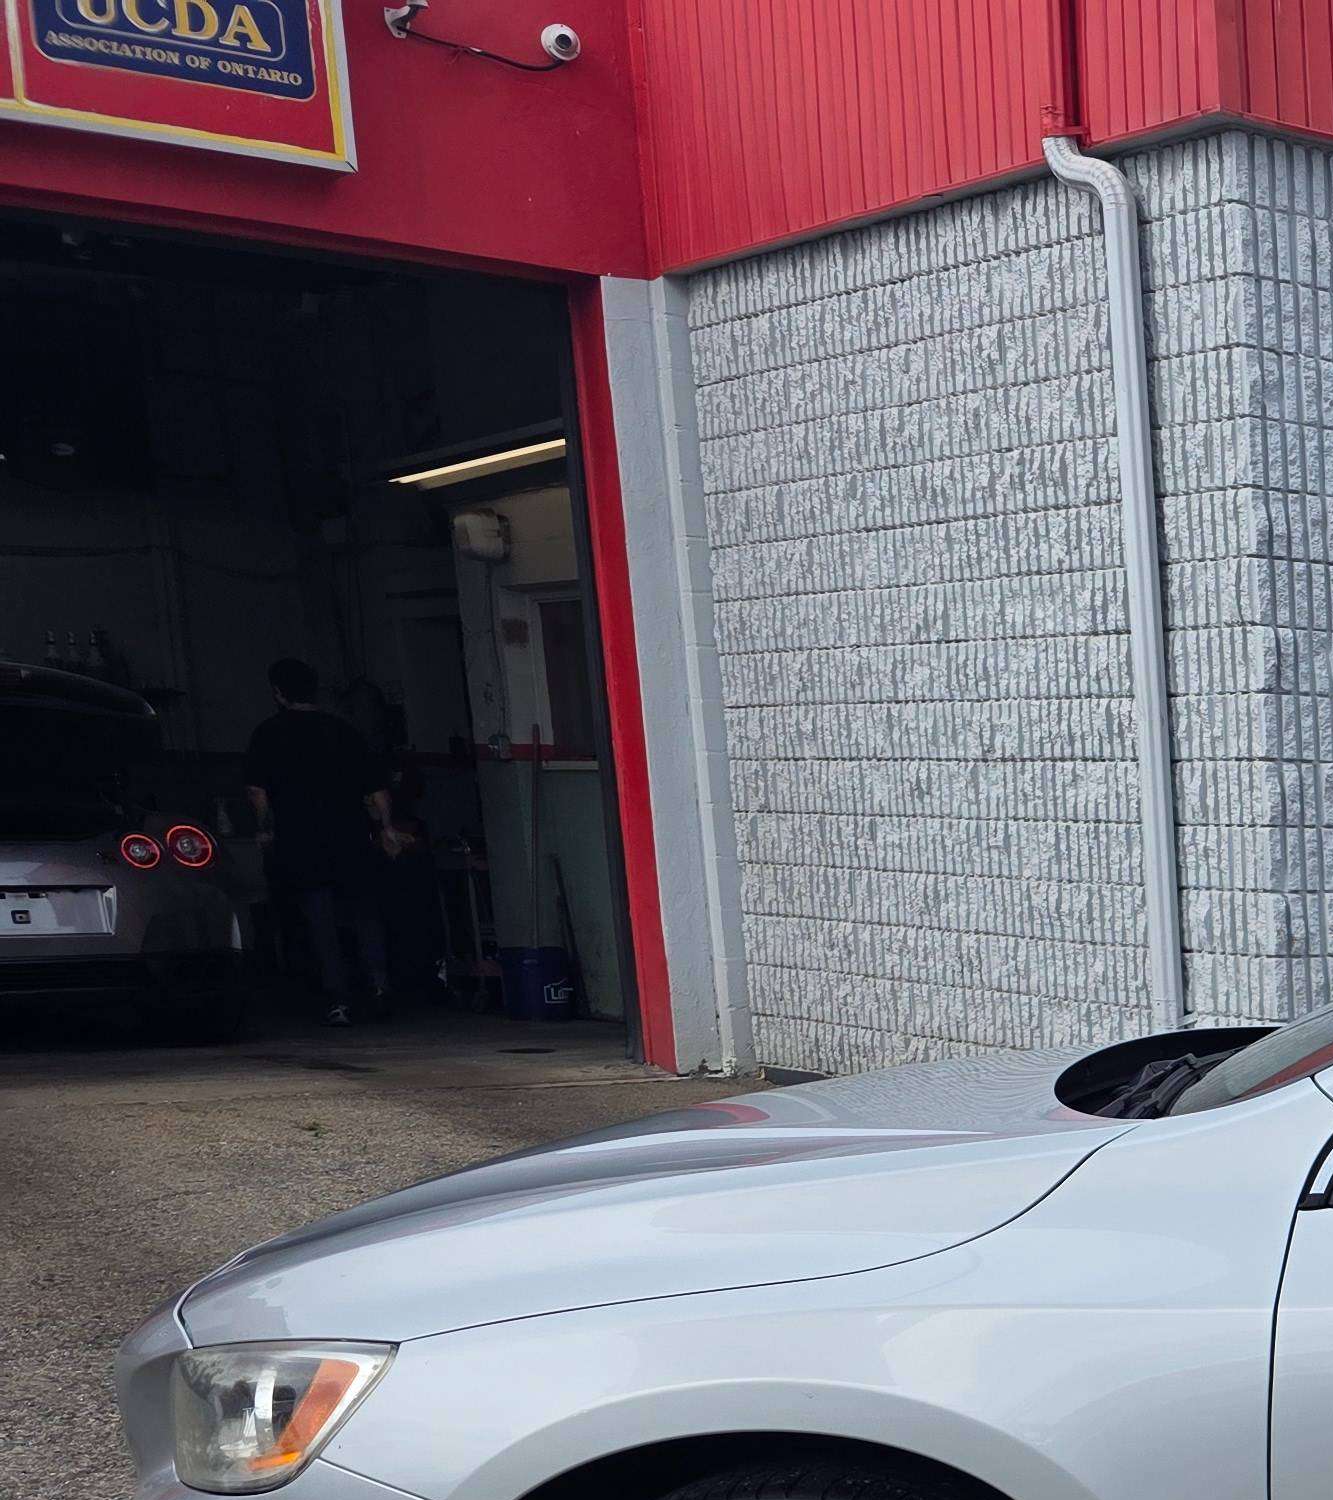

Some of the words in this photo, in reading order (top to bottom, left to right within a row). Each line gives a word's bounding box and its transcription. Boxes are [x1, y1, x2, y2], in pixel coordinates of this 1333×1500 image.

[45, 30, 180, 65] ASSOCIATION
[186, 55, 212, 71] OF
[217, 61, 302, 86] ONTARIO
